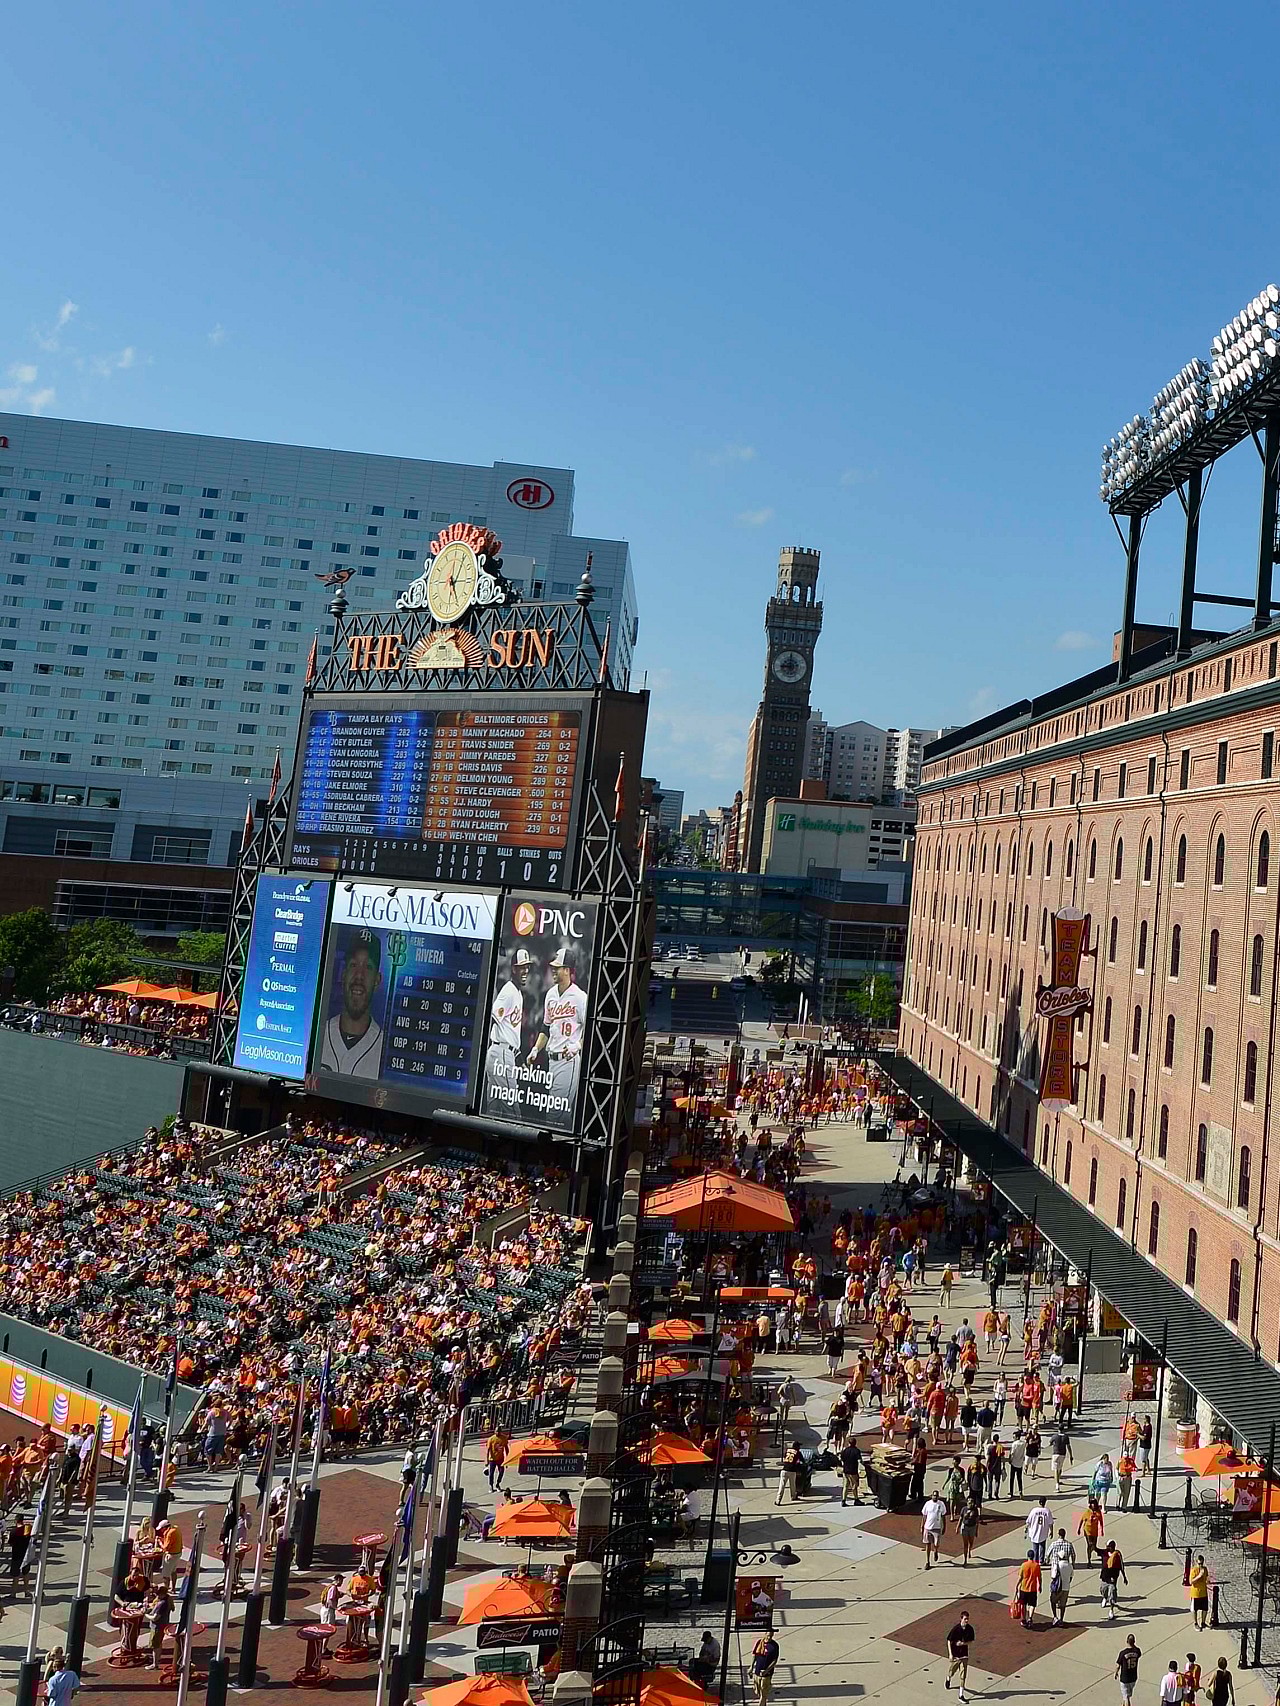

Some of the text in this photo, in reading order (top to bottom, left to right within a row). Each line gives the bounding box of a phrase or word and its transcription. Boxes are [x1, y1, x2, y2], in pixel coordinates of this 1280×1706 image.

[430, 522, 485, 555] ORIOLES
[345, 628, 555, 670] THE SUN
[474, 716, 549, 724] BALTIMORE ORIOLES
[363, 728, 385, 736] GUYER
[462, 729, 572, 738] MANNY MACHADO .264 0-1
[461, 740, 487, 748] TRAVIS
[488, 741, 514, 749] SNIDER
[534, 742, 550, 750] .269
[346, 750, 379, 758] LONGORIA
[459, 752, 569, 762] JIMMY PAREDES .327 0-2
[328, 760, 383, 769] LOGAN FORSYTHE
[458, 763, 568, 774] CHRIS DAVIS .226 0-2
[352, 771, 373, 779] SOUZA
[488, 775, 513, 783] YOUNG
[530, 777, 546, 785] .289
[555, 778, 566, 786] 0-2
[342, 782, 368, 790] ELMORE
[479, 788, 522, 797] CLEVENGER
[529, 789, 544, 797] .600
[554, 790, 565, 798] 1-1
[334, 803, 365, 812] BECKHAM
[454, 798, 563, 809] J.J. HARDY .195 0-1
[338, 814, 361, 822] RIVERA
[452, 810, 561, 822] DAVID LOUGH .275 0-1
[319, 824, 374, 834] ERASMO RAMIREZ
[451, 821, 560, 834] RYAN FLAHERTY .239 0-1
[449, 832, 498, 842] WEI-YIN CHEN
[293, 844, 310, 854] RAYS
[497, 848, 512, 857] BALLS
[519, 849, 540, 859] STRIKES
[292, 856, 318, 866] ORIOLES
[548, 851, 562, 860] OUTS
[500, 861, 506, 879] 1
[524, 862, 531, 881] 0
[548, 864, 558, 883] 2
[346, 890, 480, 930] LEGG MASON
[538, 908, 586, 939] PNC
[416, 948, 444, 965] RIVERA
[1059, 923, 1077, 982] TEAM
[272, 962, 295, 973] PERMAL
[458, 970, 478, 979] Catcher
[403, 976, 471, 995] AB 130 BB 4
[1040, 988, 1088, 1011] Orioles
[402, 997, 469, 1016] H 20 SB 0
[396, 1016, 466, 1037] AVG .154 2B 6
[241, 1041, 302, 1065] LeggMason.com
[393, 1037, 464, 1058] OBP .191 HR 2
[1050, 1020, 1069, 1094] STORE
[392, 1058, 461, 1079] SLG .246 RBI 9
[493, 1058, 553, 1090] for making
[490, 1084, 571, 1112] magic happen.
[532, 1628, 559, 1637] PATIO
